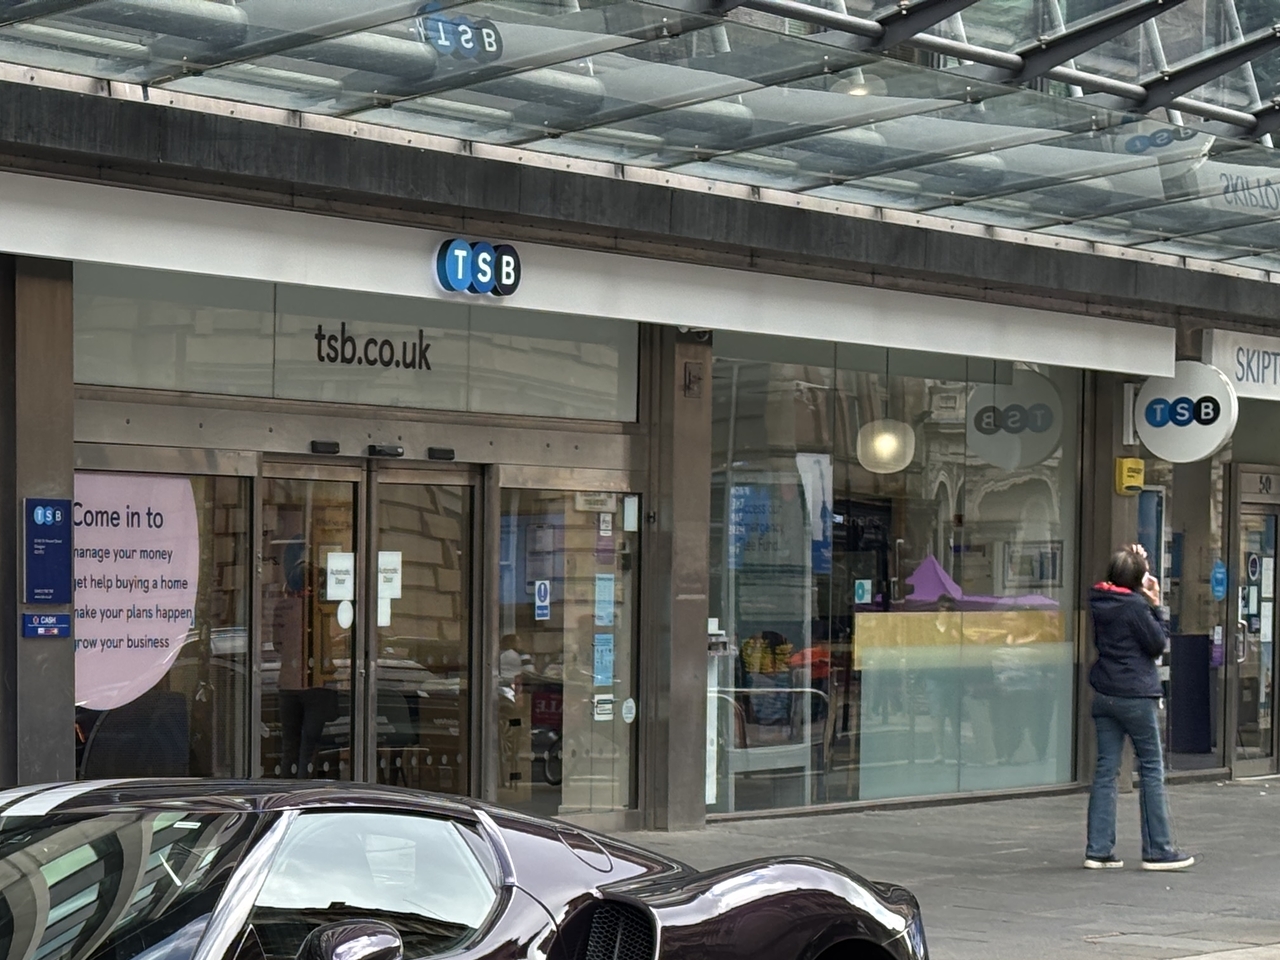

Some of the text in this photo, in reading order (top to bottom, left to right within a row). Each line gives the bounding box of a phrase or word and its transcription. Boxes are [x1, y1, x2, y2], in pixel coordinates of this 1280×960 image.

[454, 249, 515, 285] TSB
[314, 321, 432, 371] tsb.co.uk
[1235, 346, 1280, 385] SKIPT
[1154, 401, 1216, 420] TSB
[73, 502, 164, 529] Come in to
[113, 549, 137, 563] your
[140, 549, 173, 564] money
[90, 575, 113, 592] help
[116, 575, 149, 593] buying
[152, 580, 158, 589] a
[161, 575, 188, 589] home
[100, 608, 124, 623] your
[127, 604, 153, 623] plans
[100, 638, 124, 653] your
[127, 634, 170, 649] business
